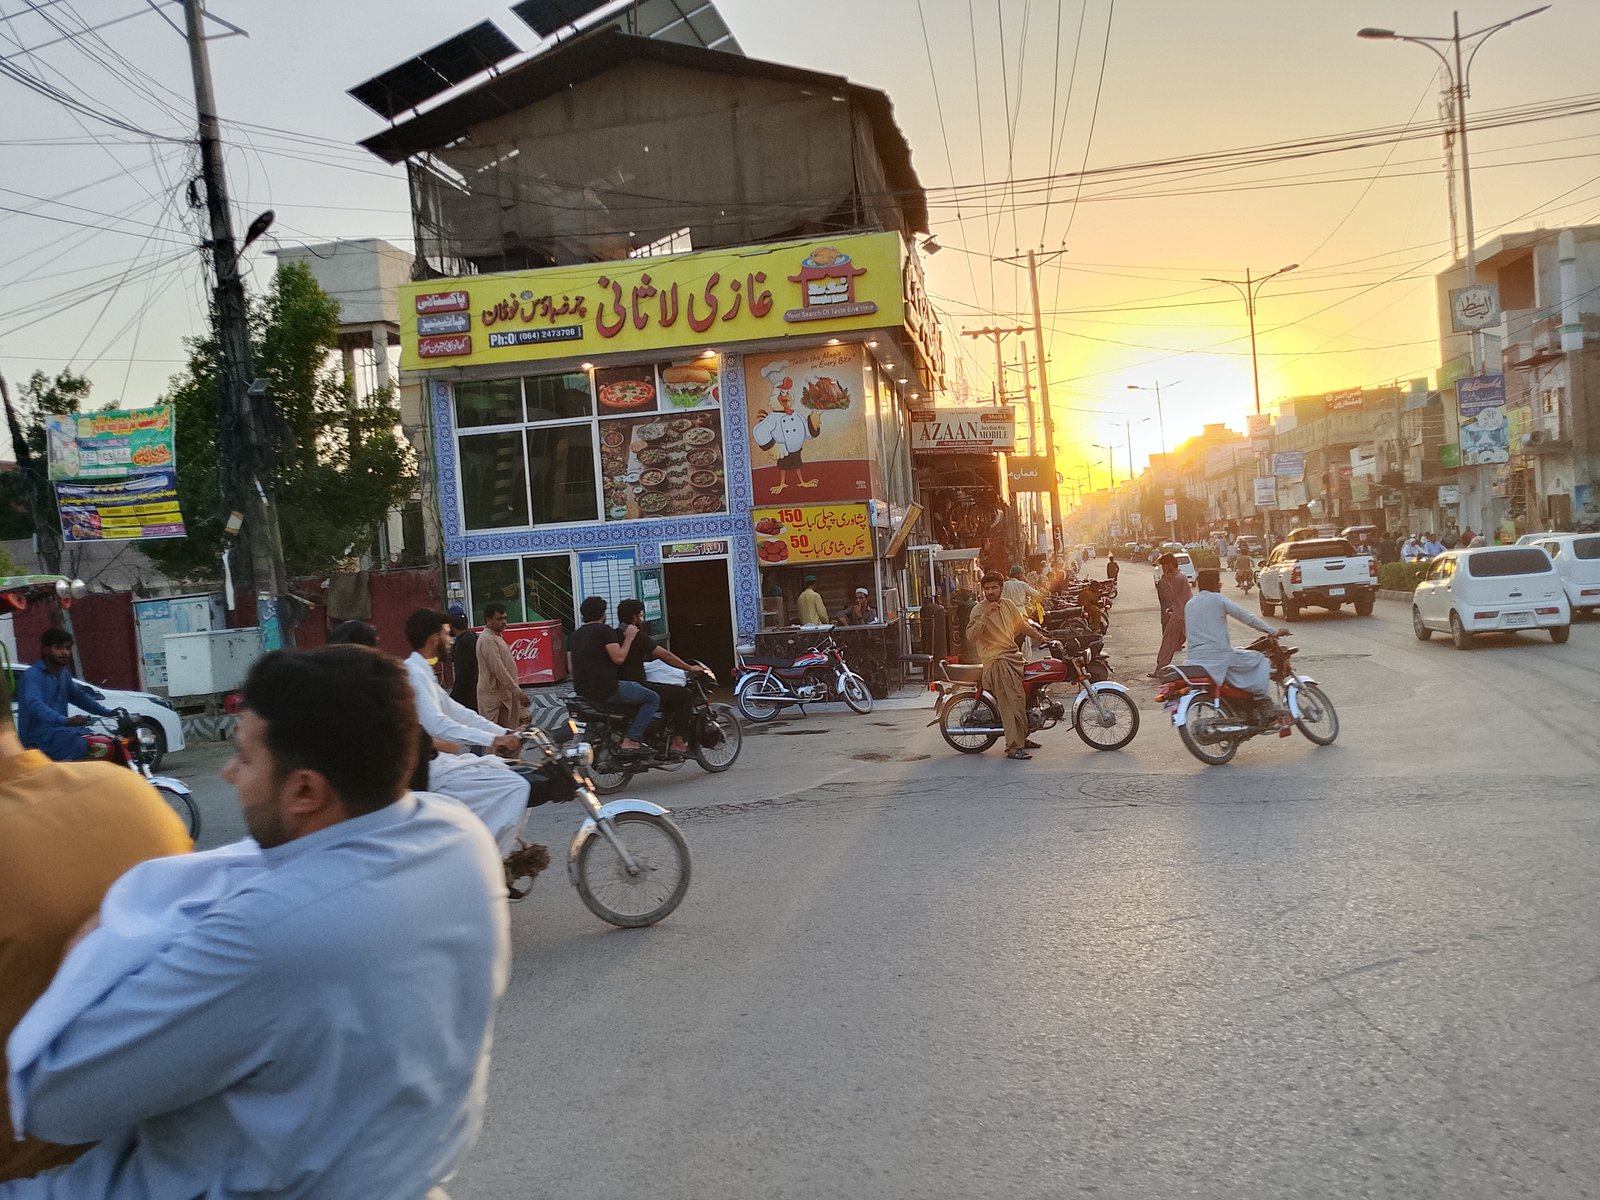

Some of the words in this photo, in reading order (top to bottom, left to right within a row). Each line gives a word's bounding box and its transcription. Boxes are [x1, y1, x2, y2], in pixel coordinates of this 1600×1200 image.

[417, 292, 466, 310] پاکستانی
[687, 271, 773, 333] غازی
[541, 328, 575, 338] 2473708
[919, 421, 978, 441] AZAAN
[979, 430, 1009, 439] MOBILE
[777, 508, 803, 523] 150
[792, 512, 822, 532] کباب
[836, 512, 867, 530] پشاوری
[789, 534, 809, 548] 50
[799, 539, 829, 558] کباب
[823, 540, 845, 556] شامی
[844, 533, 865, 556] چکن
